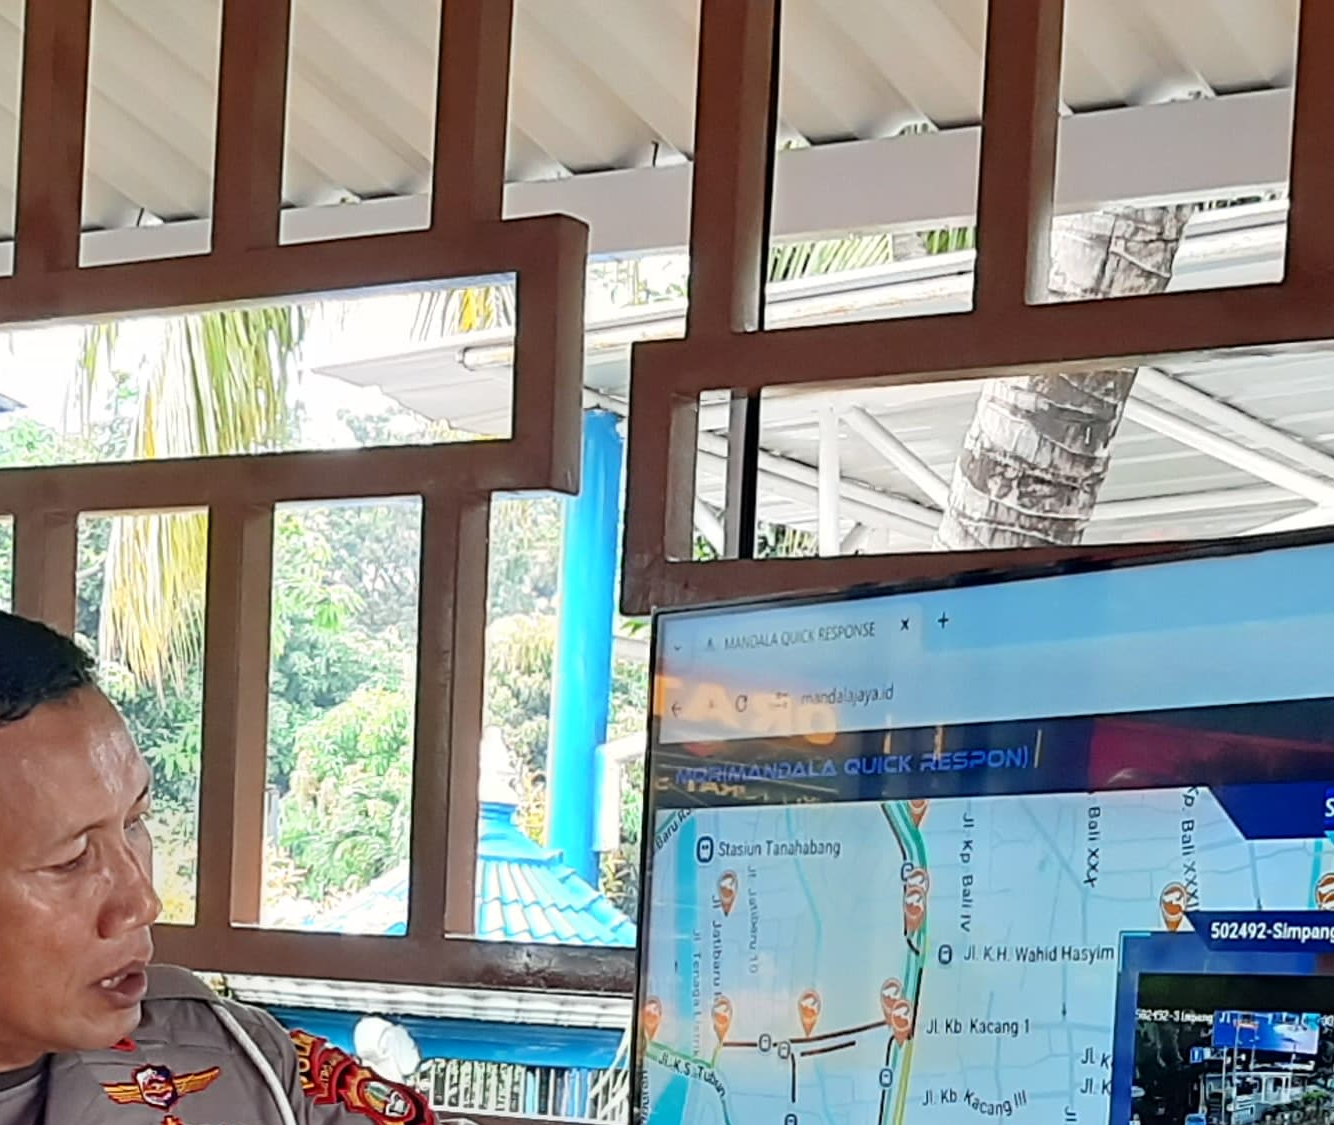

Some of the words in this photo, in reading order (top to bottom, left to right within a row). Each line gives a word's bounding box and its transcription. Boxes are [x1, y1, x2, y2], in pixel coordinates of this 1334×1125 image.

[724, 631, 778, 650] MANDALA
[781, 628, 815, 647] QUICK
[818, 621, 876, 641] RESPONSE
[844, 755, 913, 775] QUICK
[1088, 806, 1101, 842] Bali
[718, 842, 762, 857] Stasiun
[766, 840, 841, 858] Tanahabang
[1181, 820, 1195, 856] Bali
[961, 875, 974, 908] Bali
[712, 920, 722, 988] Jatibaru
[1015, 945, 1057, 962] Wahid
[1061, 944, 1114, 965] Hasyim
[970, 1019, 1018, 1036] Kacang
[964, 1090, 1011, 1116] Kacang
